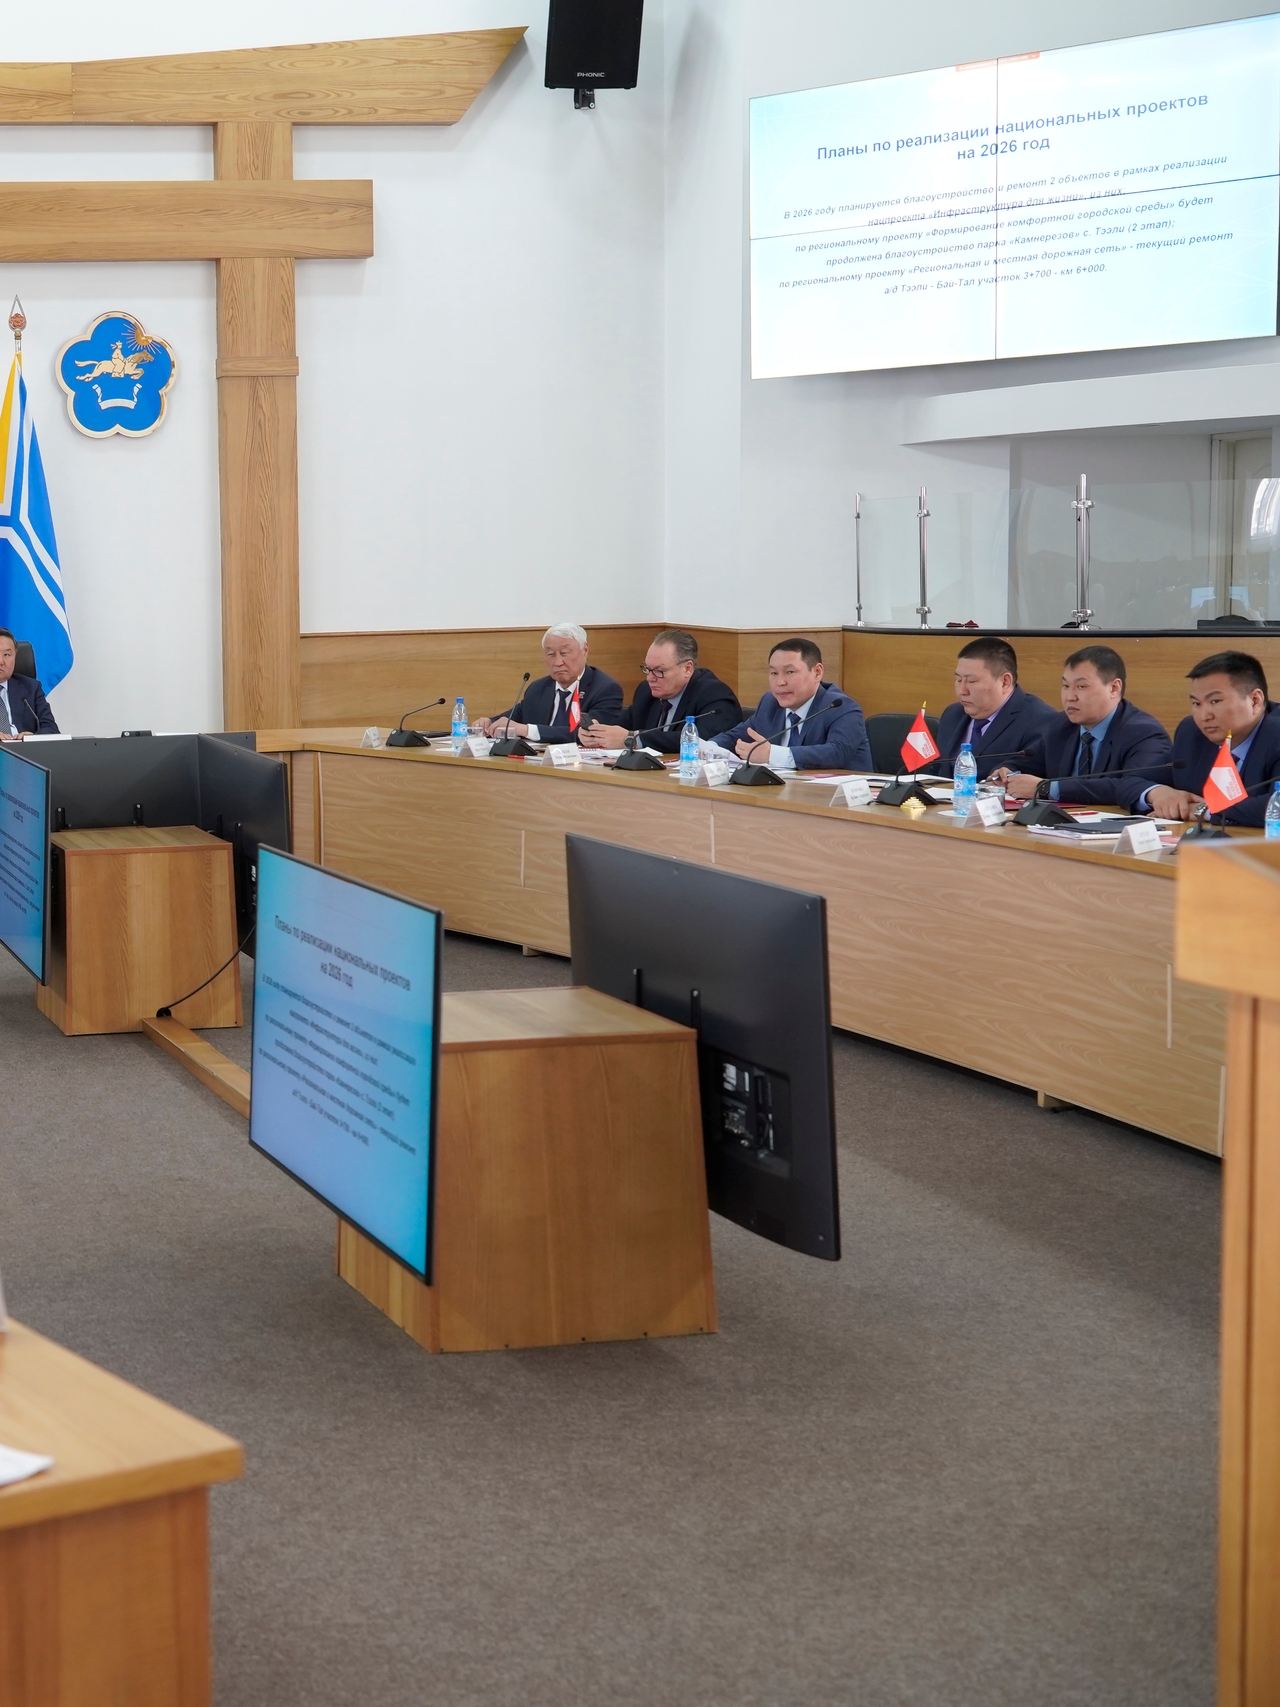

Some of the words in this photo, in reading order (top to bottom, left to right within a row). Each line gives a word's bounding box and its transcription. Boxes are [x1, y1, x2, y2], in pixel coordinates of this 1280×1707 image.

[817, 145, 868, 159] Планы
[873, 142, 891, 151] по
[896, 128, 989, 151] реализации
[995, 107, 1120, 134] национальных
[1127, 96, 1209, 117] проектов
[958, 149, 975, 159] на
[980, 140, 1017, 157] 2026
[1023, 139, 1050, 150] год
[793, 209, 813, 217] 2026
[815, 206, 836, 215] году
[838, 199, 901, 212] планируется
[903, 187, 994, 204] благоустройство
[1006, 180, 1047, 192] ремонт
[1050, 177, 1056, 185] 2
[1058, 172, 1110, 183] объектов
[1122, 166, 1160, 177] рамках
[1162, 157, 1228, 172] реализации
[808, 238, 880, 252] региональному
[882, 232, 923, 243] проекту
[926, 221, 1005, 236] «Формирование
[1007, 214, 1075, 227] комфортной
[1077, 207, 1132, 219] городской
[1135, 202, 1175, 213] среды»
[1178, 197, 1214, 208] будет
[826, 254, 883, 266] продолжена
[885, 244, 975, 259] благоустройство
[977, 239, 1006, 250] парка
[1009, 232, 1080, 244] «Камнерезов»
[1095, 226, 1125, 235] Тээли
[1128, 223, 1137, 233] (2
[1140, 220, 1175, 230] этап);
[792, 274, 863, 288] региональному
[865, 269, 906, 279] проекту
[908, 261, 981, 273] «Региональная
[993, 254, 1038, 265] местная
[1041, 249, 1091, 260] дорожная
[1136, 238, 1186, 249] текущий
[1189, 233, 1233, 245] ремонт
[884, 285, 898, 294] а/д
[936, 279, 975, 288] Бай-Тал
[978, 273, 1021, 286] участок
[1023, 269, 1052, 279] 3+700
[1076, 264, 1108, 274] 6+000.
